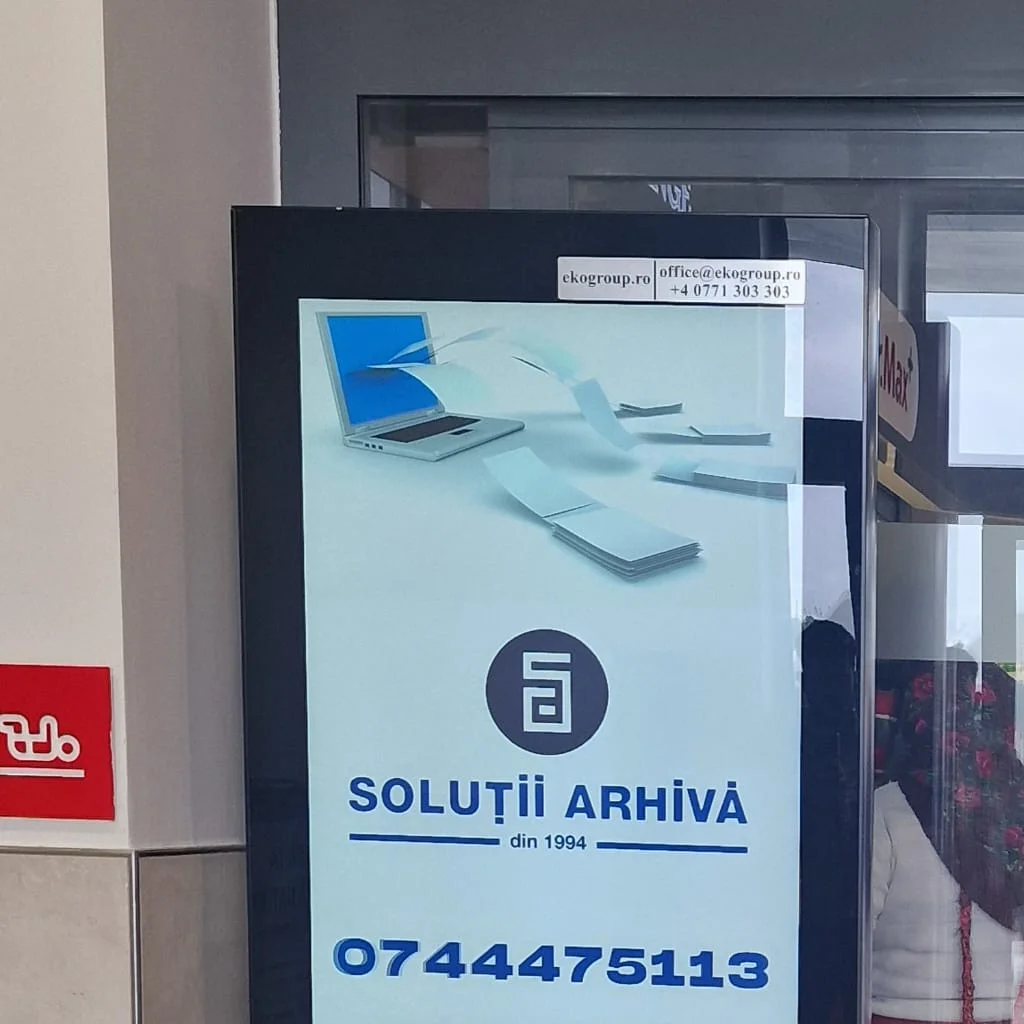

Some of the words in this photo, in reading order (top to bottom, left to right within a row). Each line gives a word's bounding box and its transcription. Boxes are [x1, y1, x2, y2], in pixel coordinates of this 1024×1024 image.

[562, 271, 651, 287] ekogroup.ro
[659, 265, 801, 284] office@ekogroup.ro
[670, 284, 688, 297] +4
[693, 284, 727, 297] 0771
[733, 285, 759, 298] 303
[764, 285, 790, 299] 303
[880, 335, 908, 413] .Max
[510, 834, 538, 849] din
[545, 834, 587, 850] 1994
[333, 937, 769, 989] 0744475113
